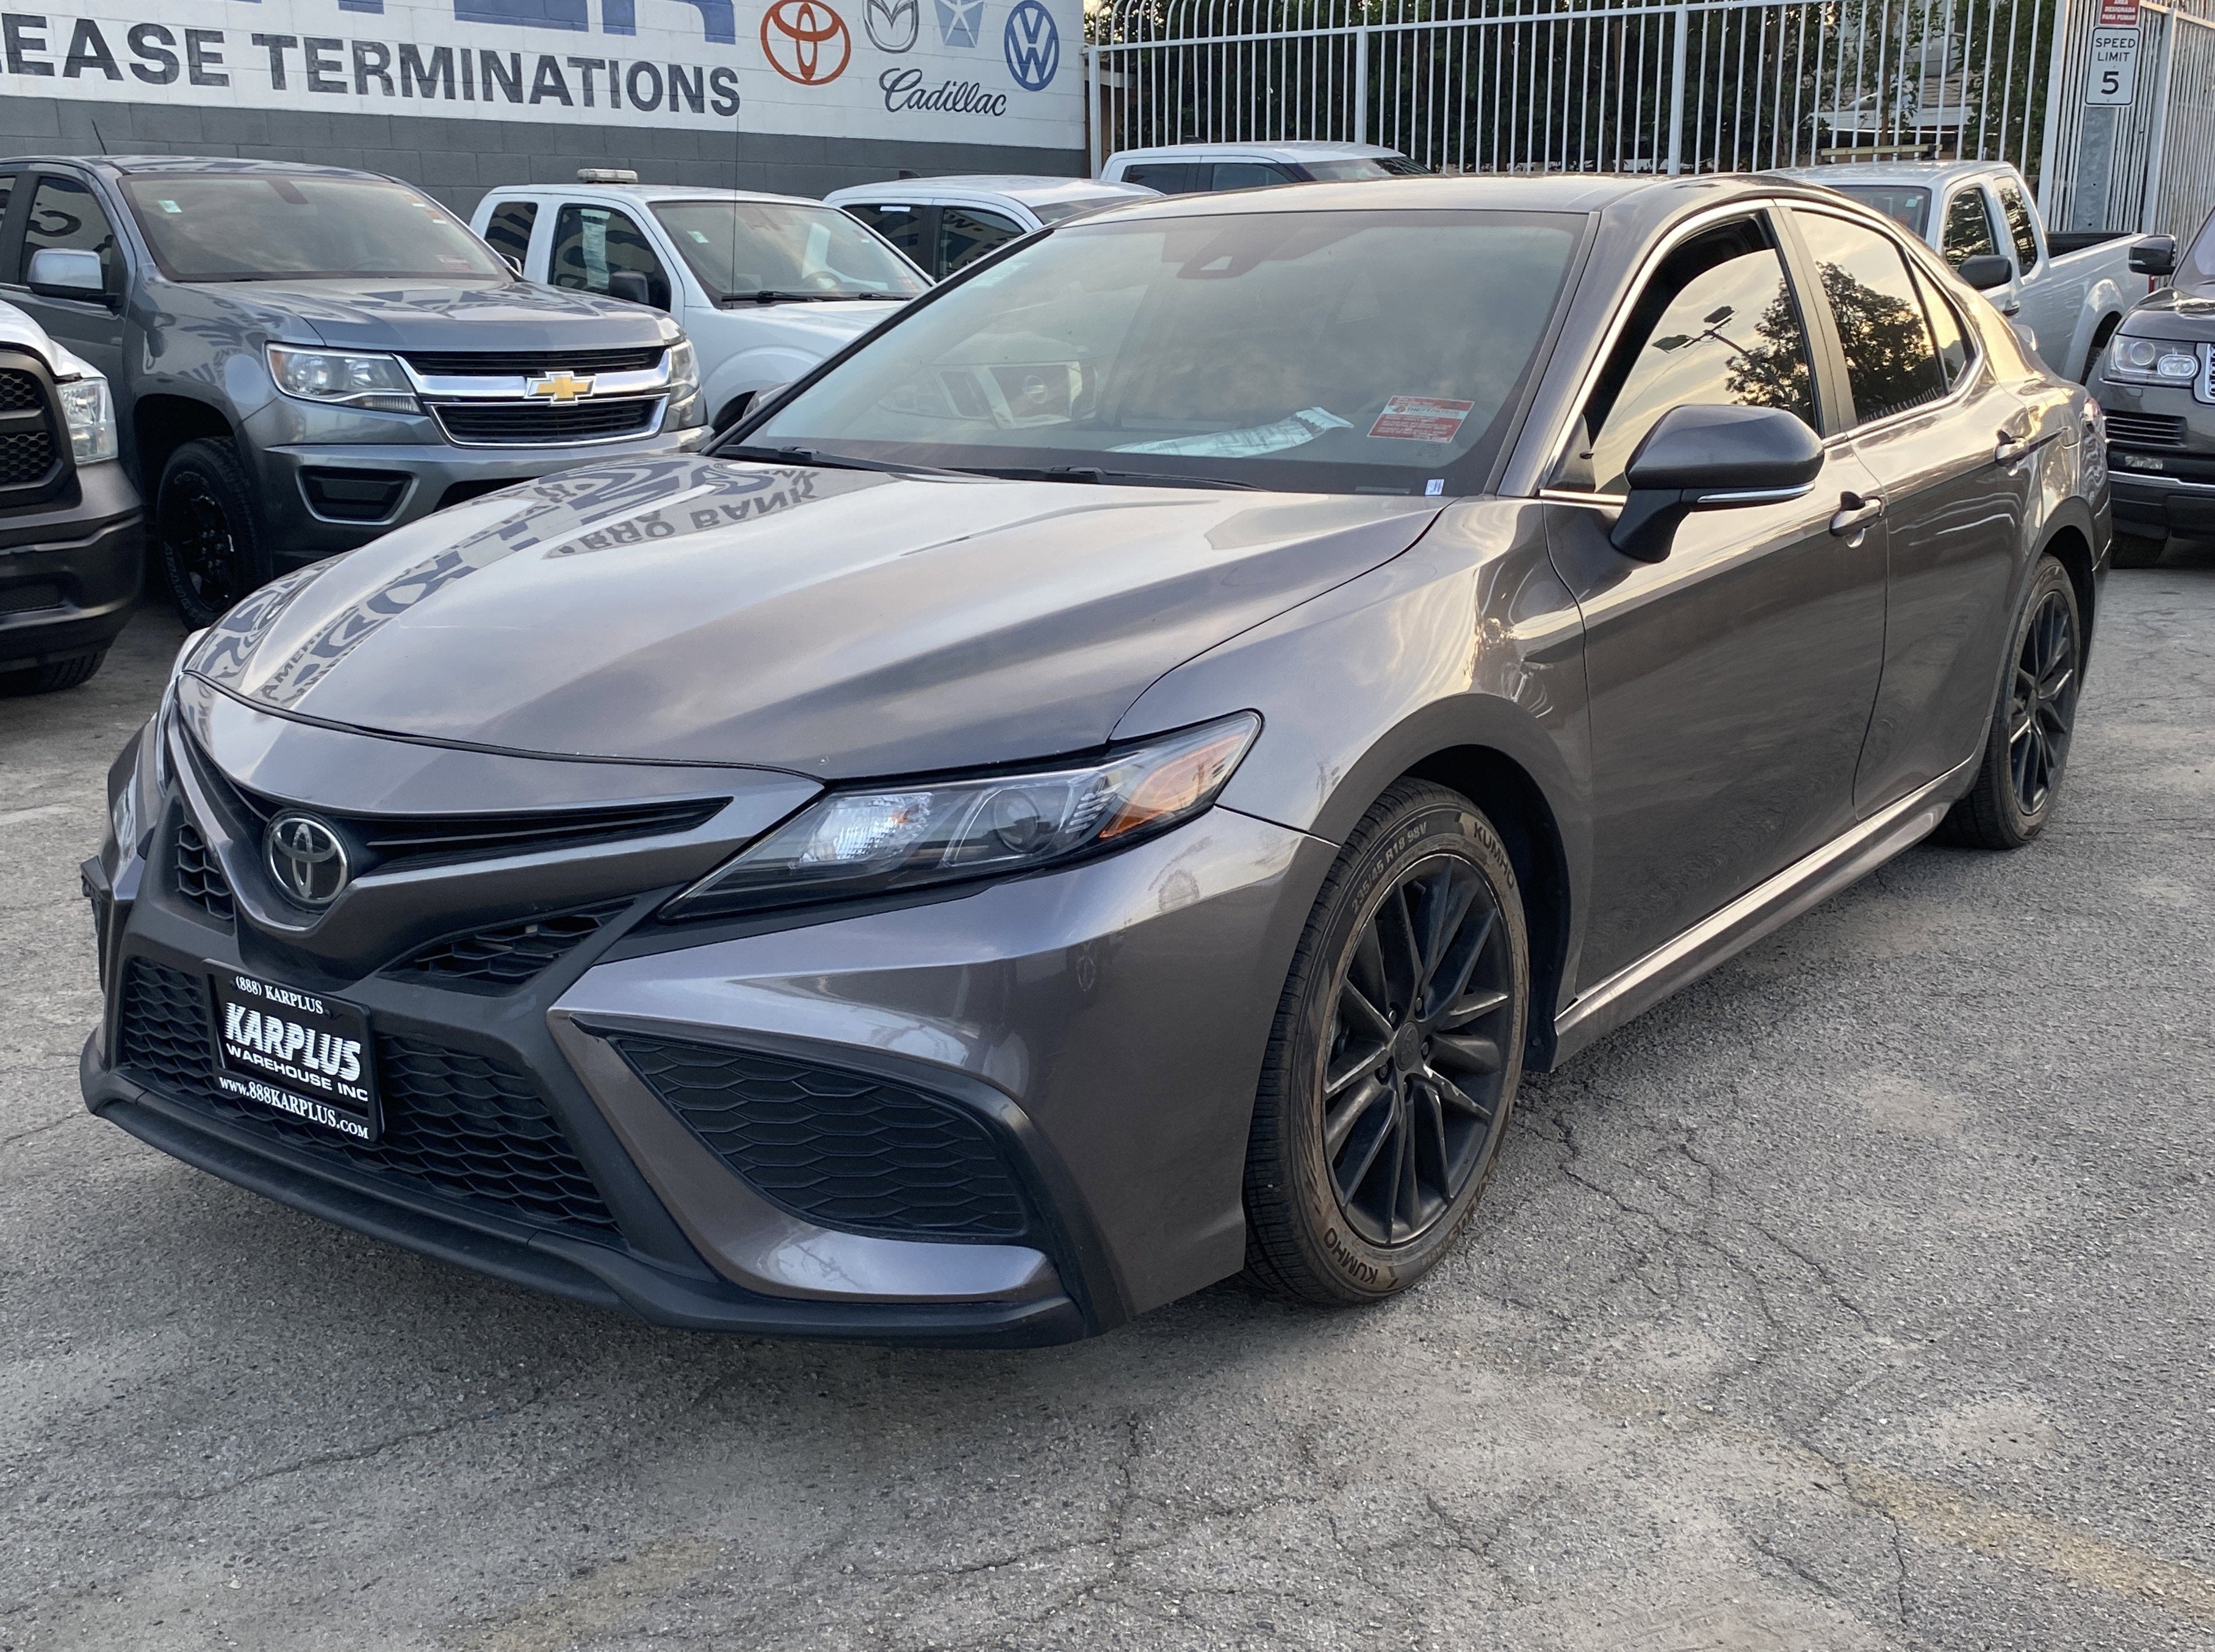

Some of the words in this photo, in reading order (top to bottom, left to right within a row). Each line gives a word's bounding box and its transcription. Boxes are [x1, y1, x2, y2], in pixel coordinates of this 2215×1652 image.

[0, 13, 229, 87] EASE
[251, 33, 740, 117] TERMINATIONS
[2095, 38, 2136, 48] SPEED
[2097, 51, 2130, 62] LIMIT
[879, 68, 1007, 117] Cadillac
[2100, 71, 2119, 95] 5
[1352, 858, 1384, 915] 235/45
[1385, 837, 1406, 864] R18
[1407, 821, 1427, 843] 98V
[1474, 822, 1514, 889] KUMHO
[236, 975, 262, 996] (888)
[264, 984, 324, 1015] KARPLUS
[225, 1002, 361, 1082] KARPLUS
[226, 1043, 333, 1091] WAREHOUSE
[337, 1082, 369, 1102] INC
[1323, 1227, 1378, 1285] KUMHO
